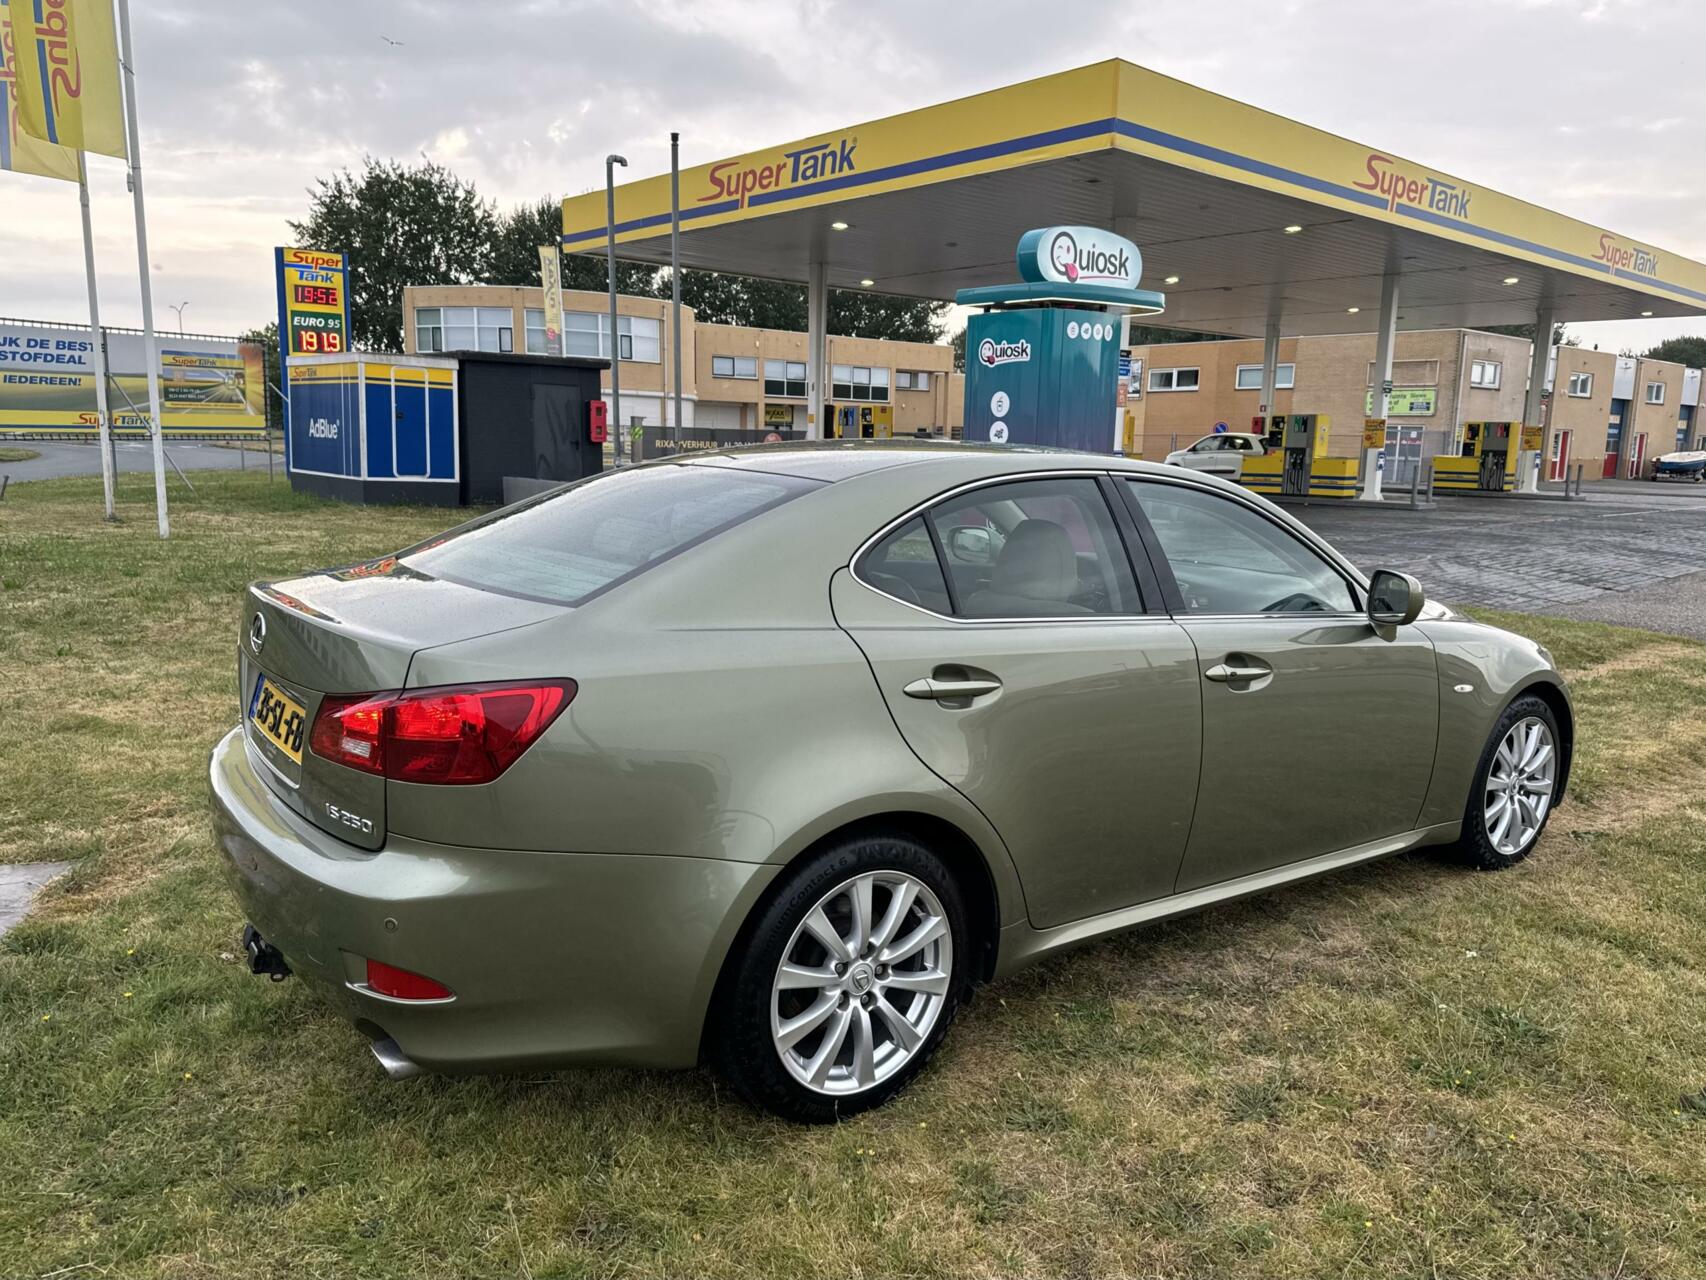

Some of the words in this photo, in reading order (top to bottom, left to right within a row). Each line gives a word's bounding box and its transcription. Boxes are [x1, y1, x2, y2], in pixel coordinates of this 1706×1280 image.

[286, 251, 341, 270] Super
[1050, 231, 1129, 283] Quiosk
[295, 269, 334, 283] Tank
[296, 287, 337, 304] 19:52
[293, 316, 325, 327] EURO
[327, 319, 341, 329] 95
[26, 338, 50, 349] DE
[980, 340, 1029, 365] Quiosk
[3, 374, 81, 387] IEDEREEN!
[72, 413, 150, 430] SurTank
